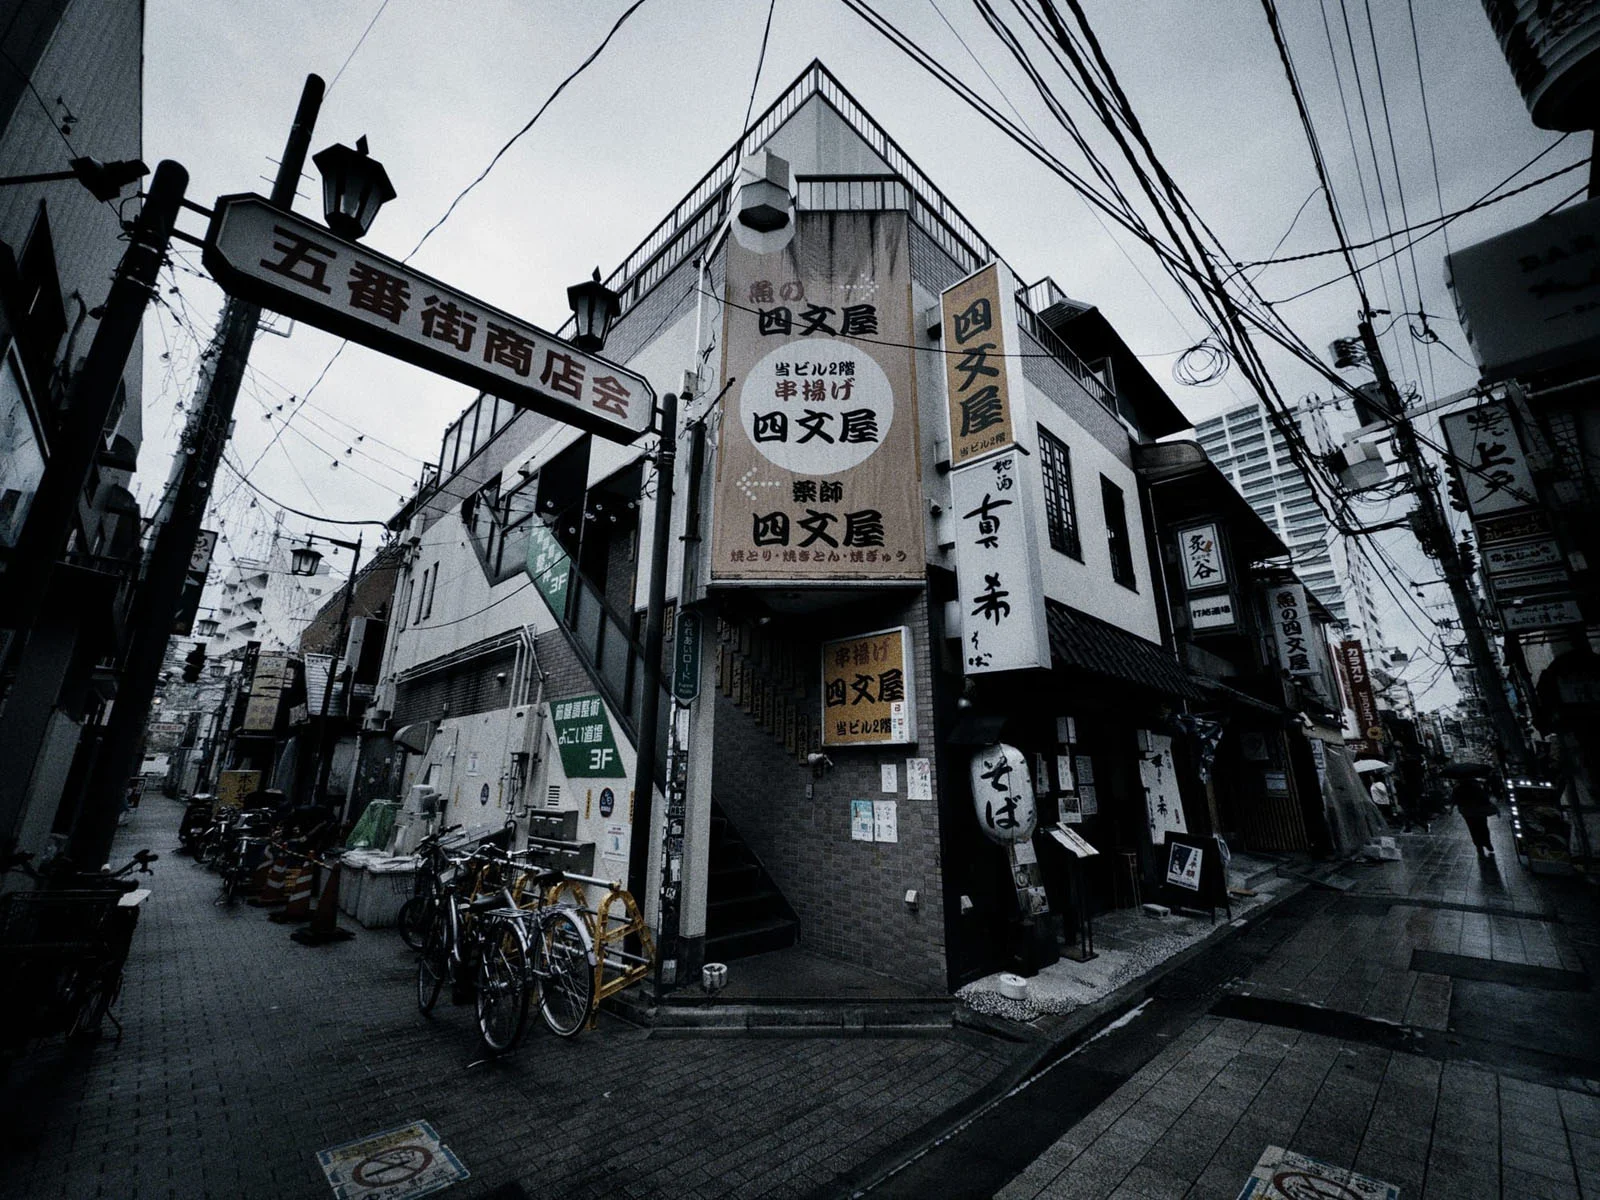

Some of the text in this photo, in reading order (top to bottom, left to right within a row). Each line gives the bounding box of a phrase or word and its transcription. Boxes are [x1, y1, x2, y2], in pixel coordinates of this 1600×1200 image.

[260, 225, 630, 419] 五番街商店会
[758, 303, 878, 336] 四文屋
[775, 361, 855, 376] 当ビル2階
[953, 298, 1004, 437] 四文屋
[775, 377, 855, 401] 串揚げ
[753, 408, 878, 444] 四文屋
[960, 432, 1006, 457] 当ビル2階
[792, 480, 843, 503] 薬師
[753, 509, 885, 548] 四文屋
[549, 572, 568, 595] 3F
[1276, 590, 1311, 671] 魚の四文屋
[835, 637, 891, 669] 串揚げ
[825, 668, 905, 707] 四文屋
[558, 724, 603, 745] よこい道場
[836, 718, 892, 736] 当ビル2階
[589, 748, 614, 770] 3F
[980, 756, 1022, 829] そば
